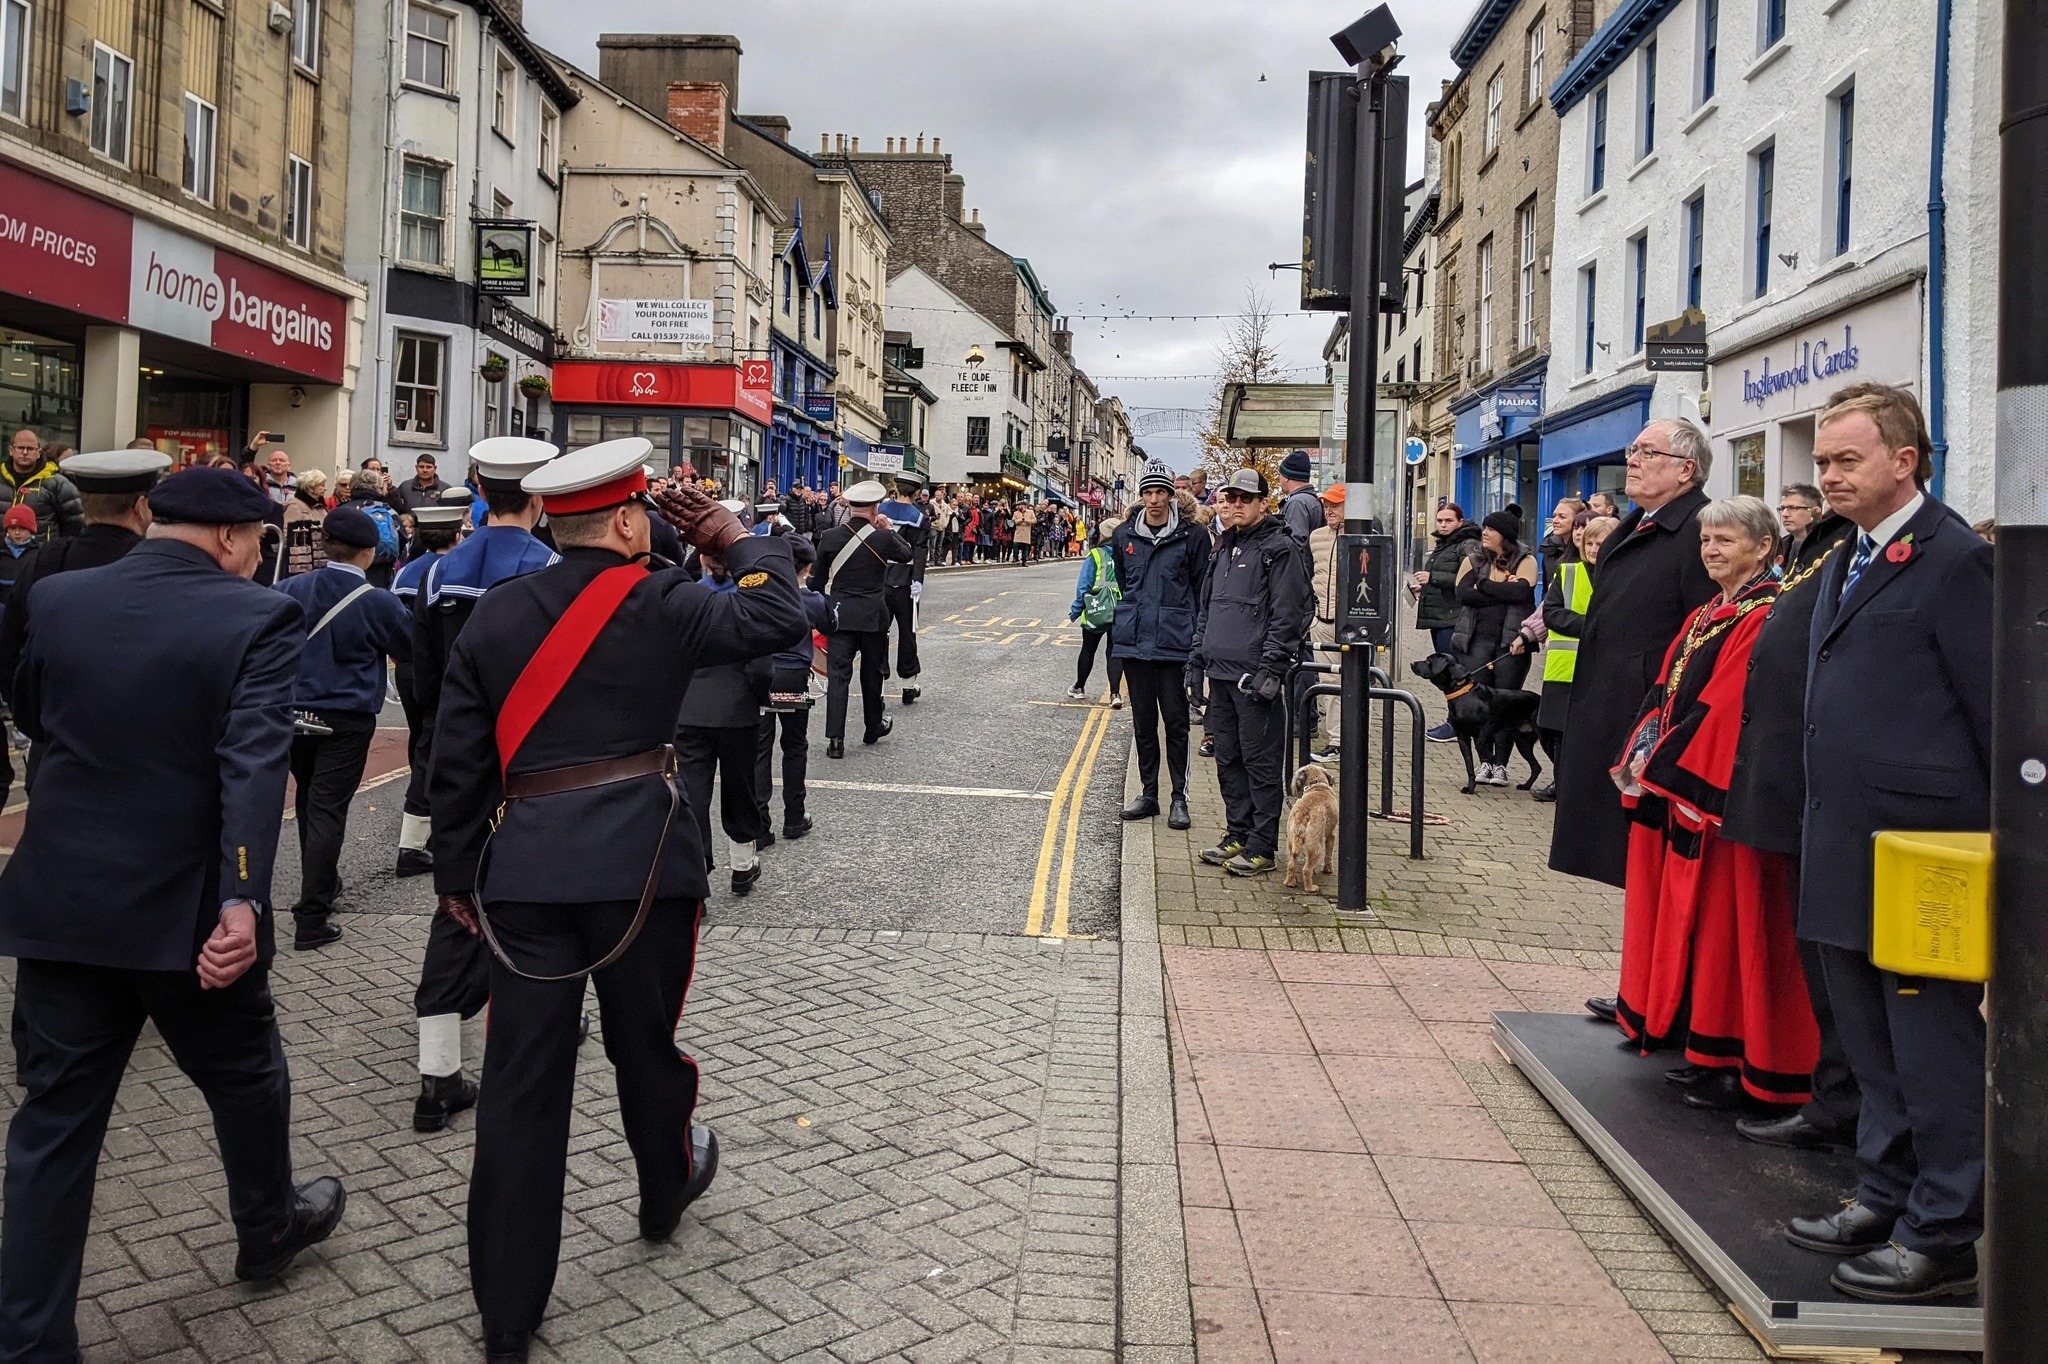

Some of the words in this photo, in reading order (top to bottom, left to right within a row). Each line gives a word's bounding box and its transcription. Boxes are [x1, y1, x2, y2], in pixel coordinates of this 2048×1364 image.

[31, 226, 97, 267] PRICES
[145, 251, 218, 313] home
[229, 278, 333, 351] bargains
[513, 320, 518, 338] &
[519, 324, 544, 352] RAINBOW
[958, 372, 967, 381] YE
[972, 373, 990, 381] OLDE
[1742, 340, 1809, 408] Inglewood
[1812, 324, 1858, 380] Cards
[951, 384, 978, 392] FLEECE
[984, 384, 997, 392] INN
